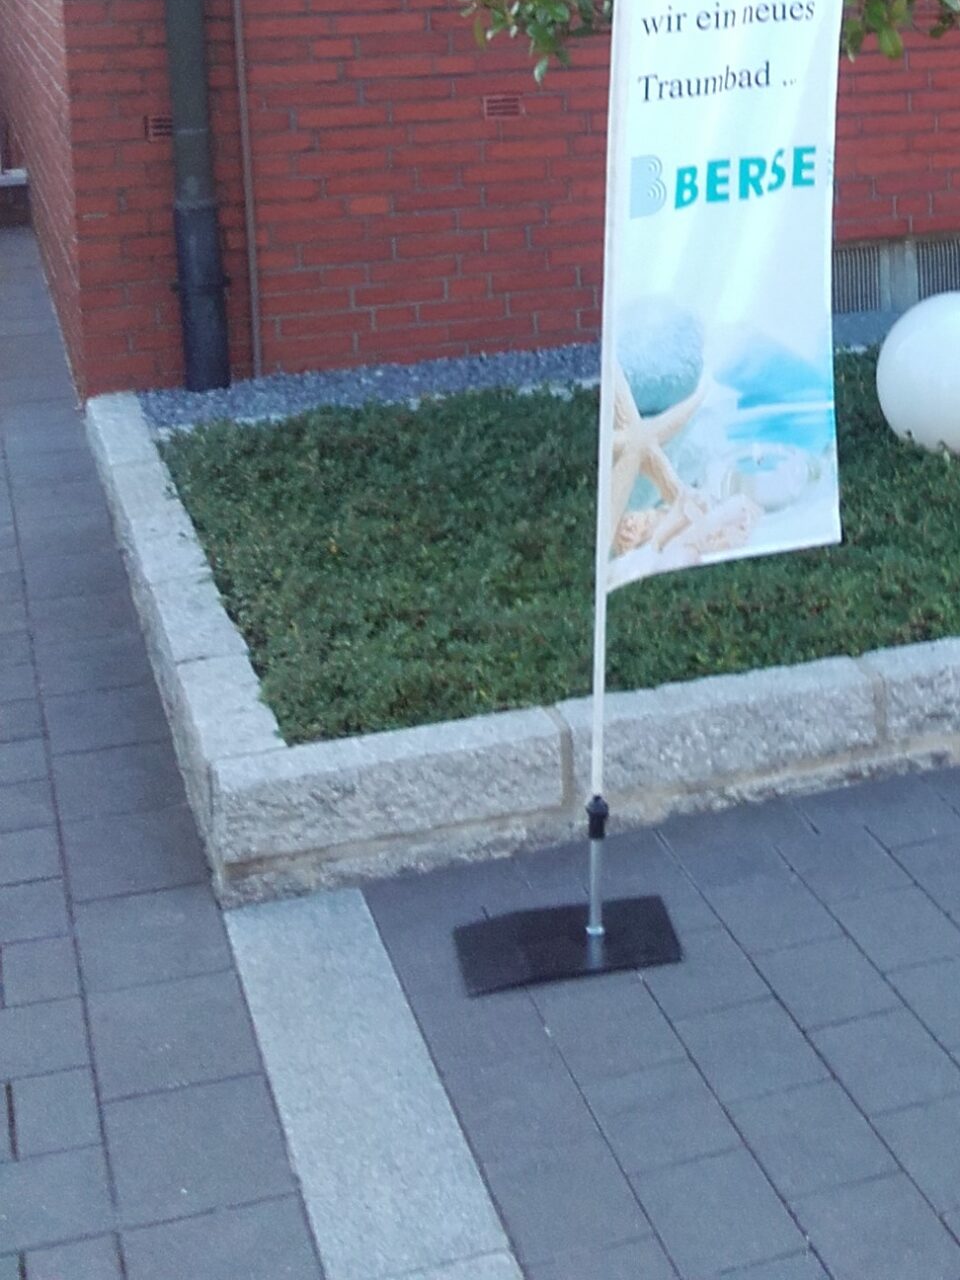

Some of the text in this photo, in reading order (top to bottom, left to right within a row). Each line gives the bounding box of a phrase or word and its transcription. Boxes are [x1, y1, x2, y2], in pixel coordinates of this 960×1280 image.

[641, 0, 816, 37] wir ein neues
[638, 61, 770, 103] Traumbad
[674, 145, 817, 211] BERSE
